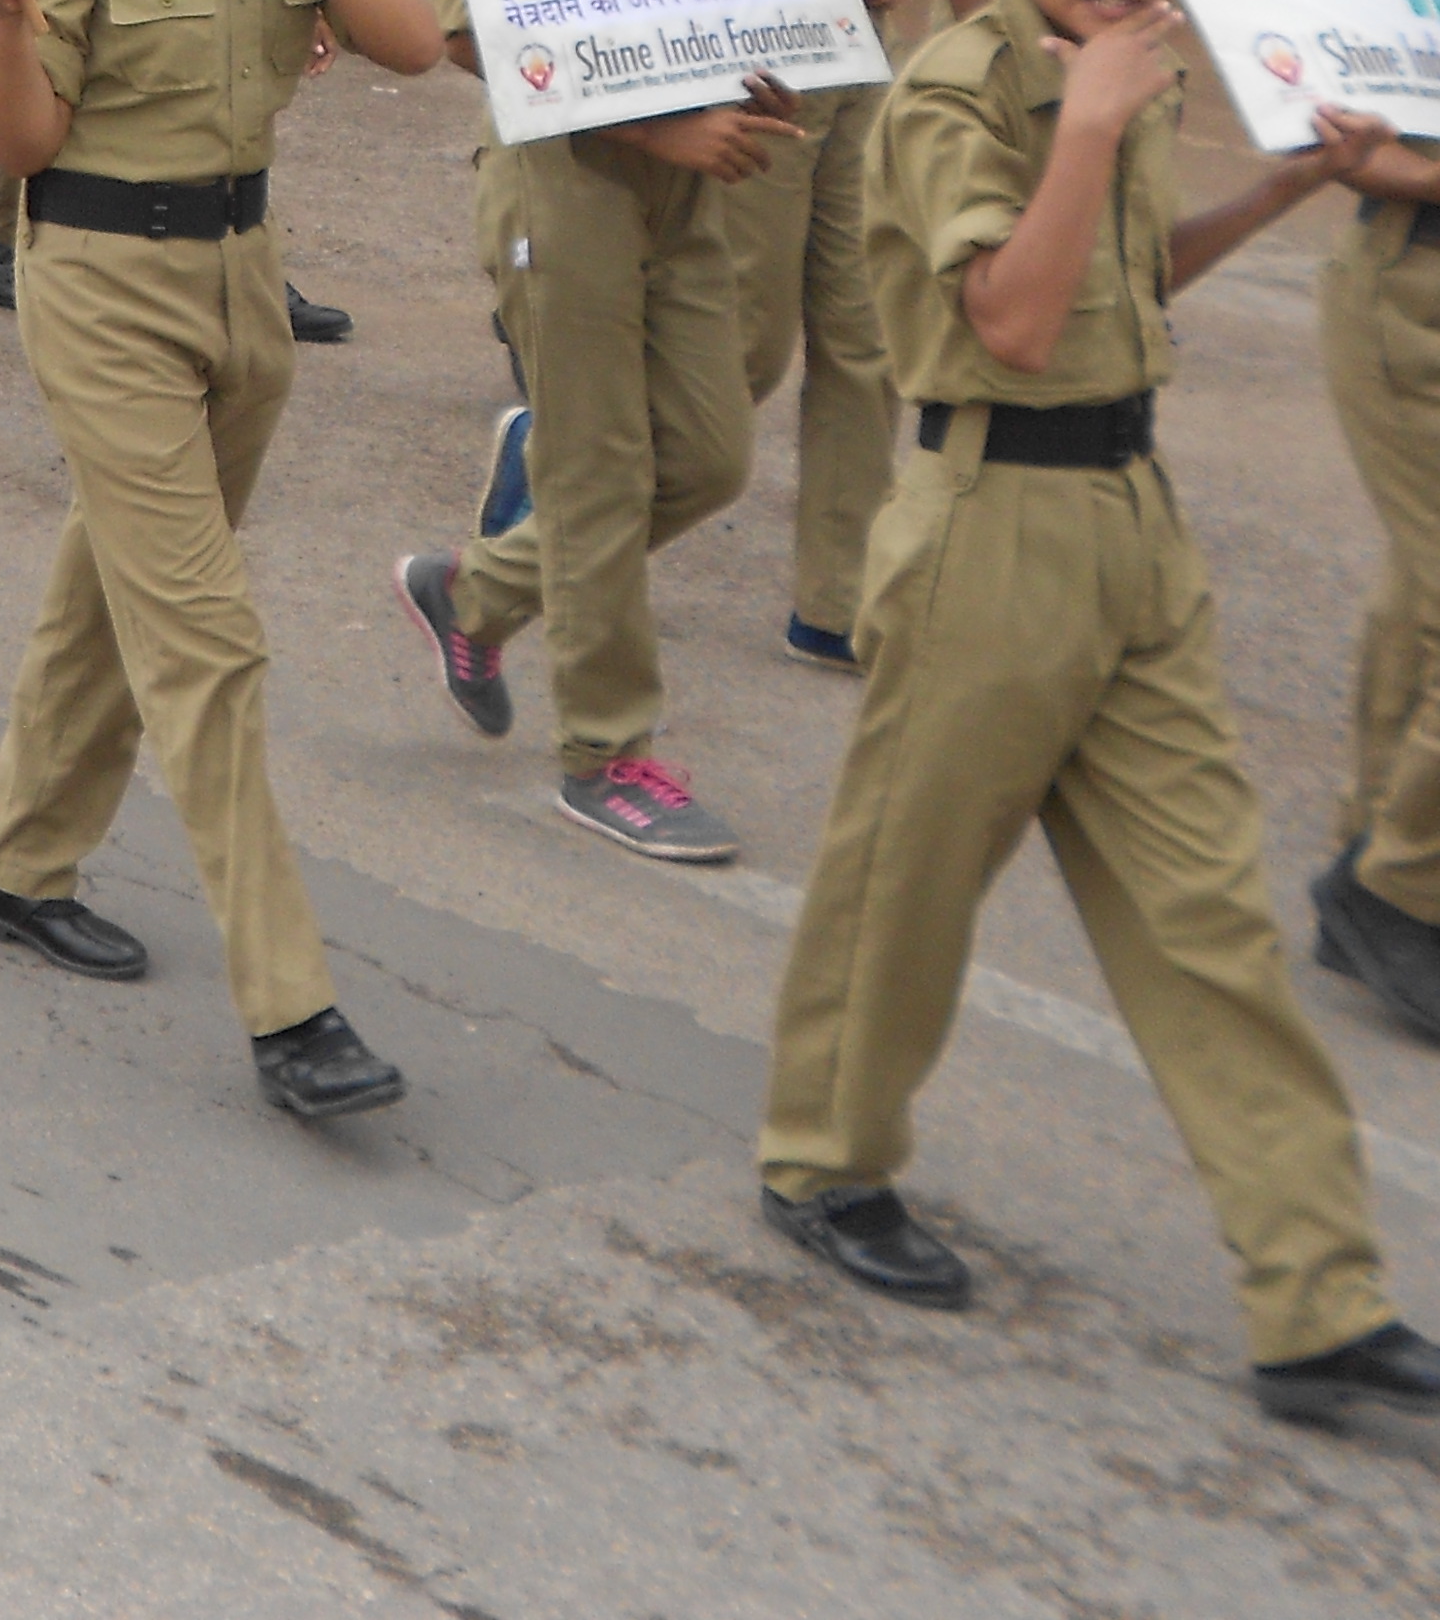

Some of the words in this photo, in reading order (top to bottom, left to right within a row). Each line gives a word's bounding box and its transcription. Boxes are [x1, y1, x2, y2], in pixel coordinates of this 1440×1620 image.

[575, 32, 655, 82] Shine
[658, 20, 722, 63] India
[724, 8, 834, 58] Foundation
[1318, 28, 1406, 77] Shine
